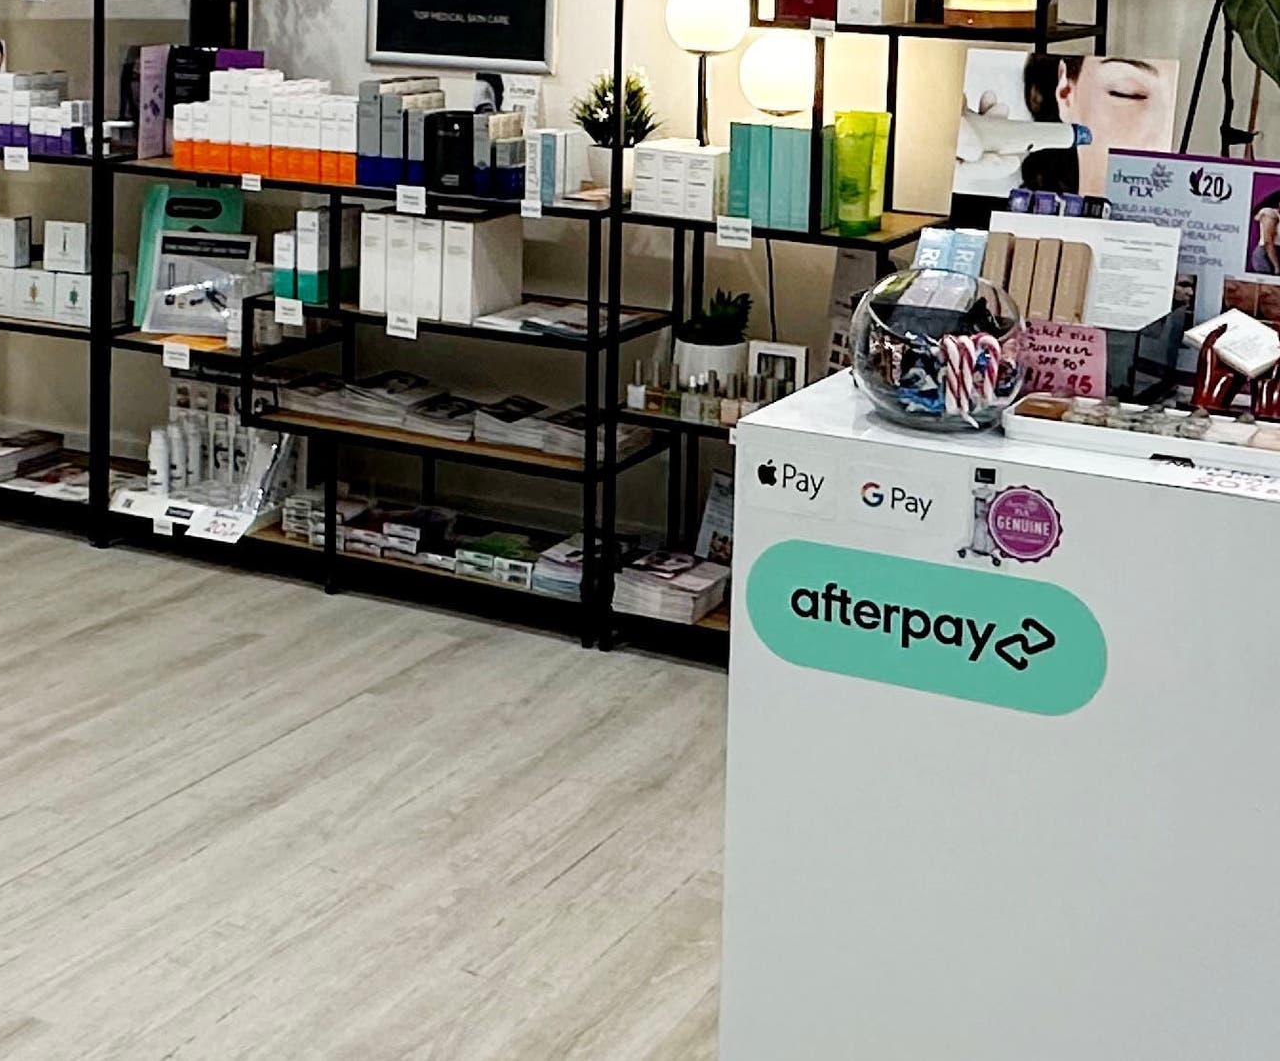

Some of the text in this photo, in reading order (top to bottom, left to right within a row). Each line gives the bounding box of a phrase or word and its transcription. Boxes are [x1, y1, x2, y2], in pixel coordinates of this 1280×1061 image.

[1129, 185, 1154, 198] FLX
[1202, 174, 1224, 198] 20
[1148, 206, 1192, 218] HEALTHY
[1186, 220, 1240, 233] COLLAGEN
[782, 462, 825, 500] Pay
[890, 487, 933, 521] Pay
[996, 514, 1051, 537] GENUINE
[790, 582, 997, 662] afterpay
